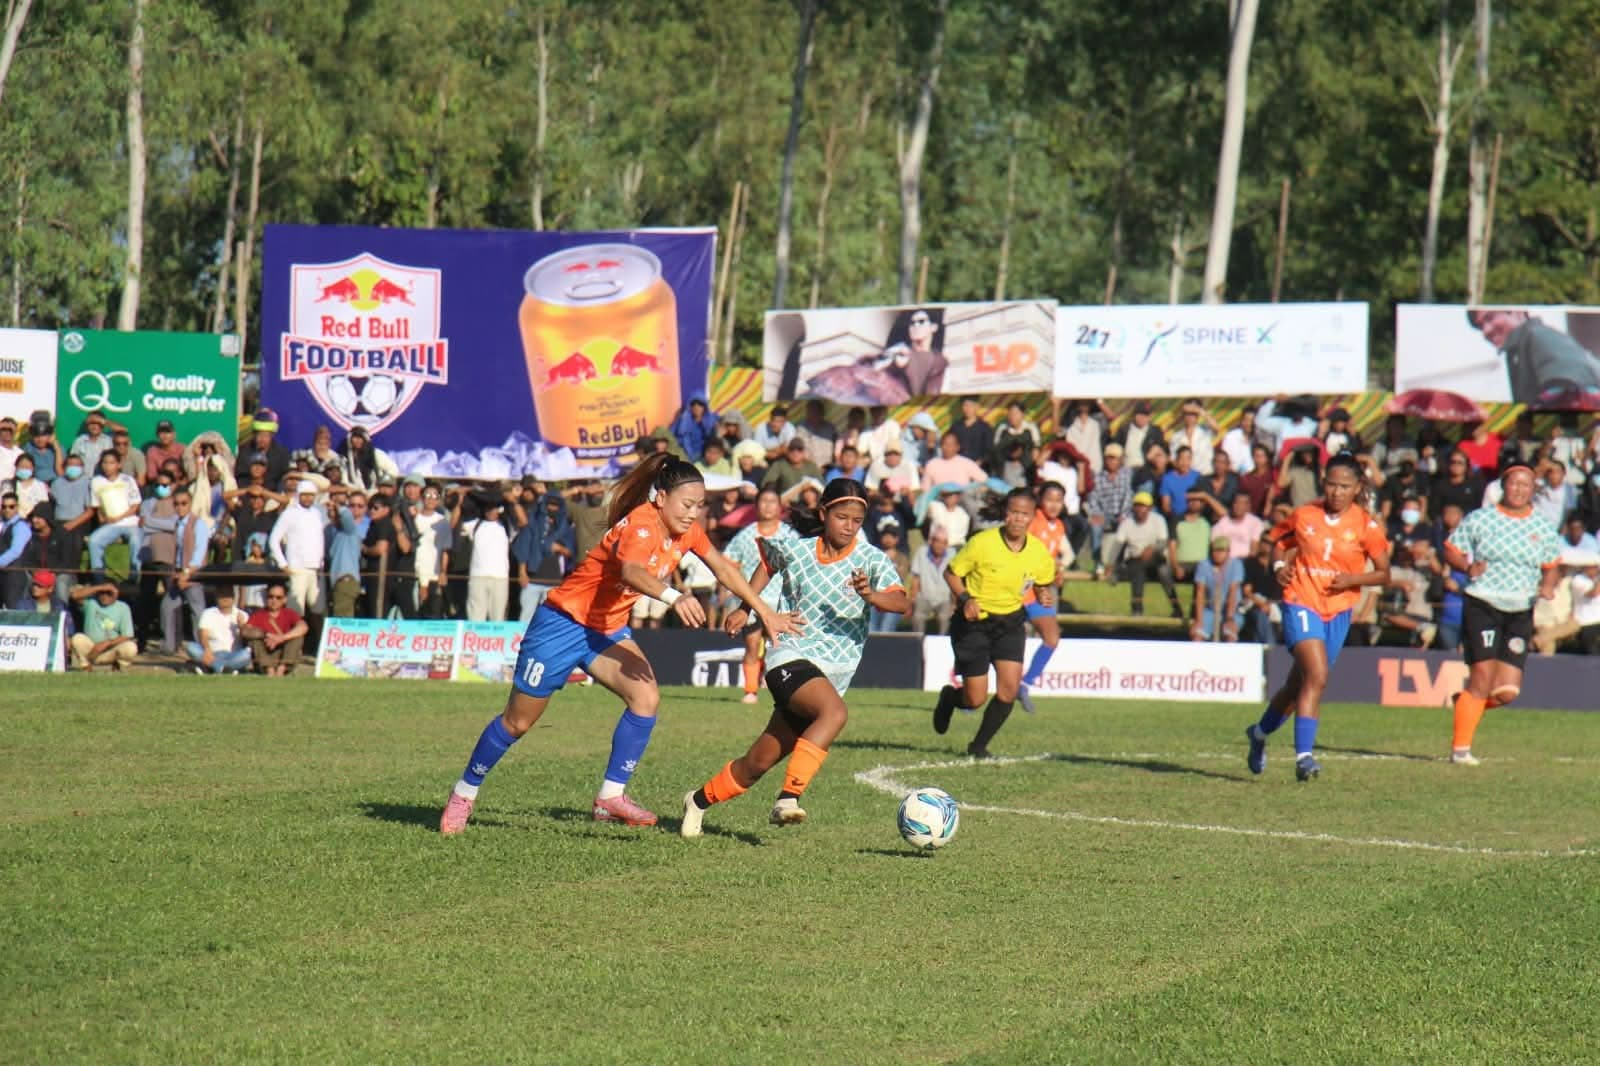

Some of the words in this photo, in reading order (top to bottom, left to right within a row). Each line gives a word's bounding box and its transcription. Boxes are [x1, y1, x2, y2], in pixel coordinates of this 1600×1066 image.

[320, 315, 361, 338] Red
[368, 317, 410, 340] Bull
[1183, 326, 1248, 345] SPINE
[288, 340, 441, 377] FOOTBALL
[69, 369, 134, 412] QC
[151, 373, 217, 396] Quality
[142, 393, 227, 414] Computer
[1297, 609, 1310, 633] 1
[1481, 629, 1497, 648] 17
[523, 657, 545, 688] 18
[692, 661, 746, 688] GA
[1119, 668, 1246, 694] नगरपालिका
